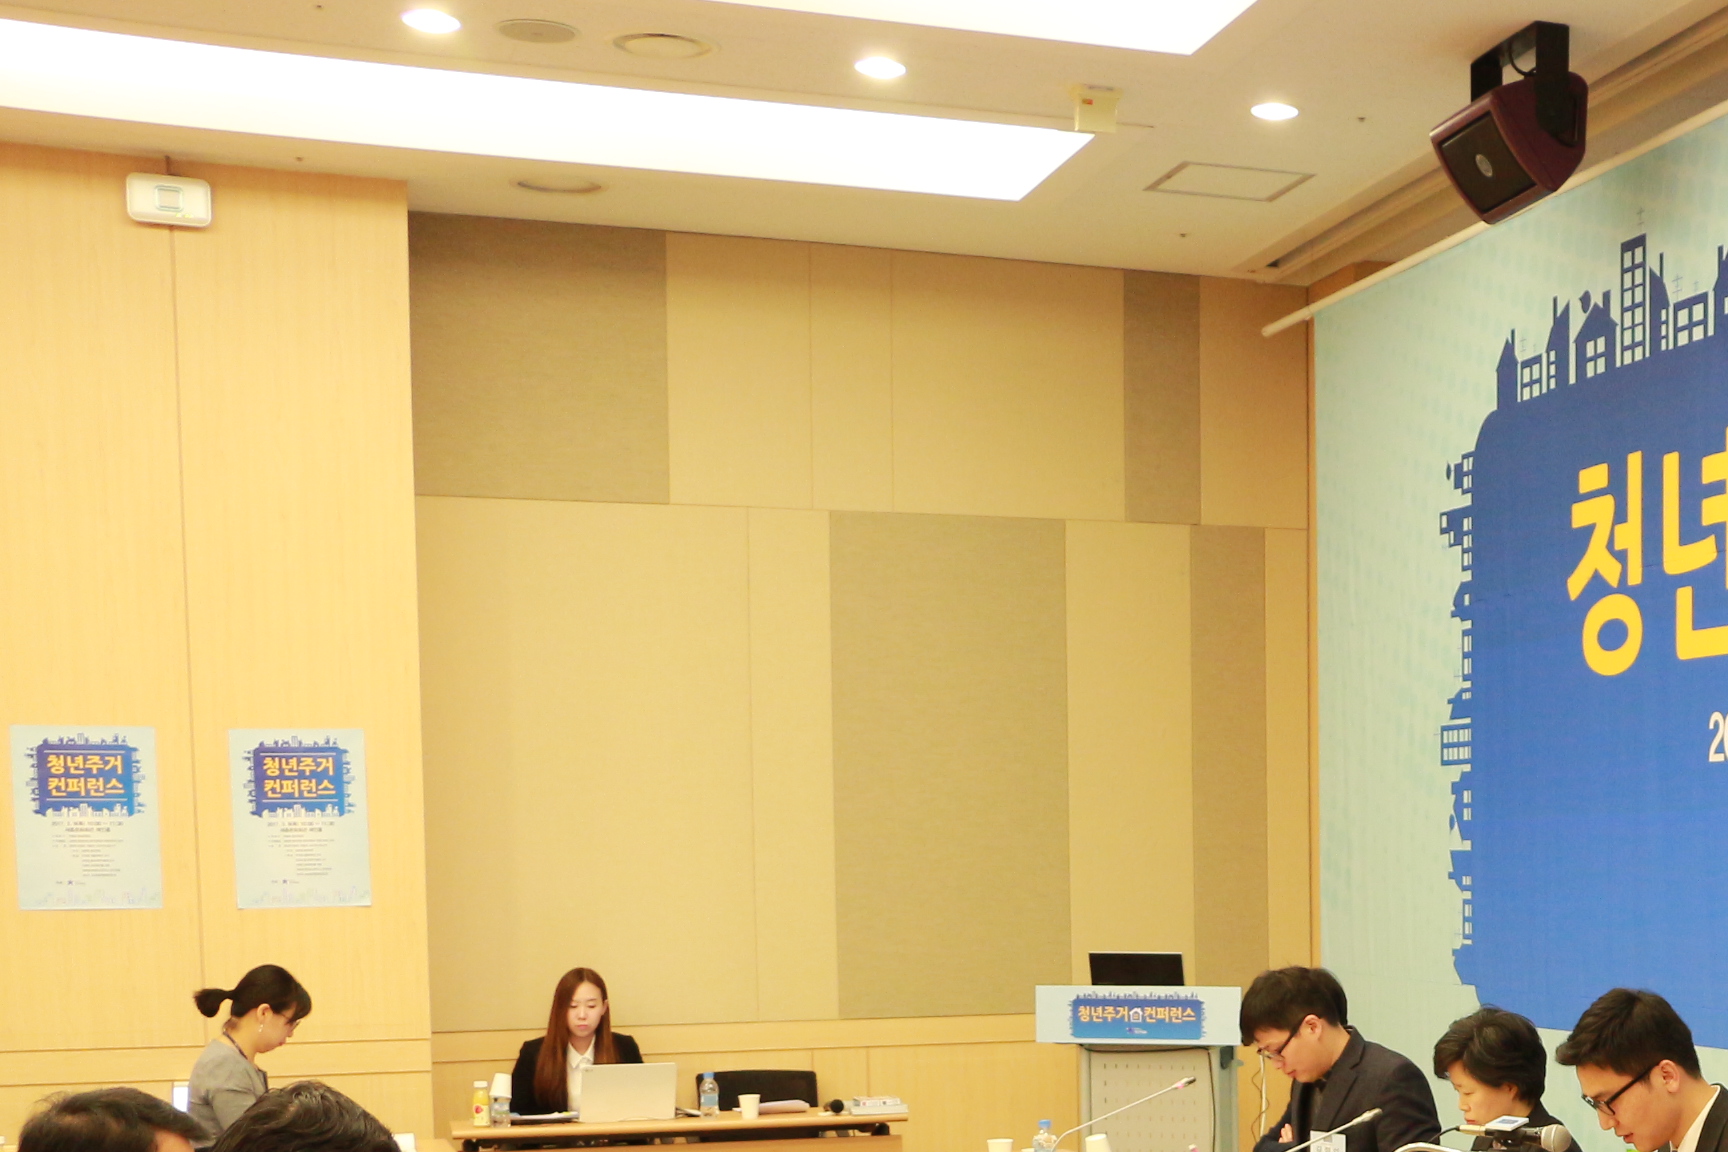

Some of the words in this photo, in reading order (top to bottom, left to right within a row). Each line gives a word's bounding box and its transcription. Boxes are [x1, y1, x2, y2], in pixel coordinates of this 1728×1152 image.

[47, 754, 123, 775] 청년주거
[263, 757, 335, 777] 청년주거
[48, 776, 125, 797] 컨퍼런스
[263, 778, 336, 798] 컨퍼런스
[1077, 1005, 1129, 1023] 청년주거
[1143, 1006, 1197, 1023] 컨퍼런스
